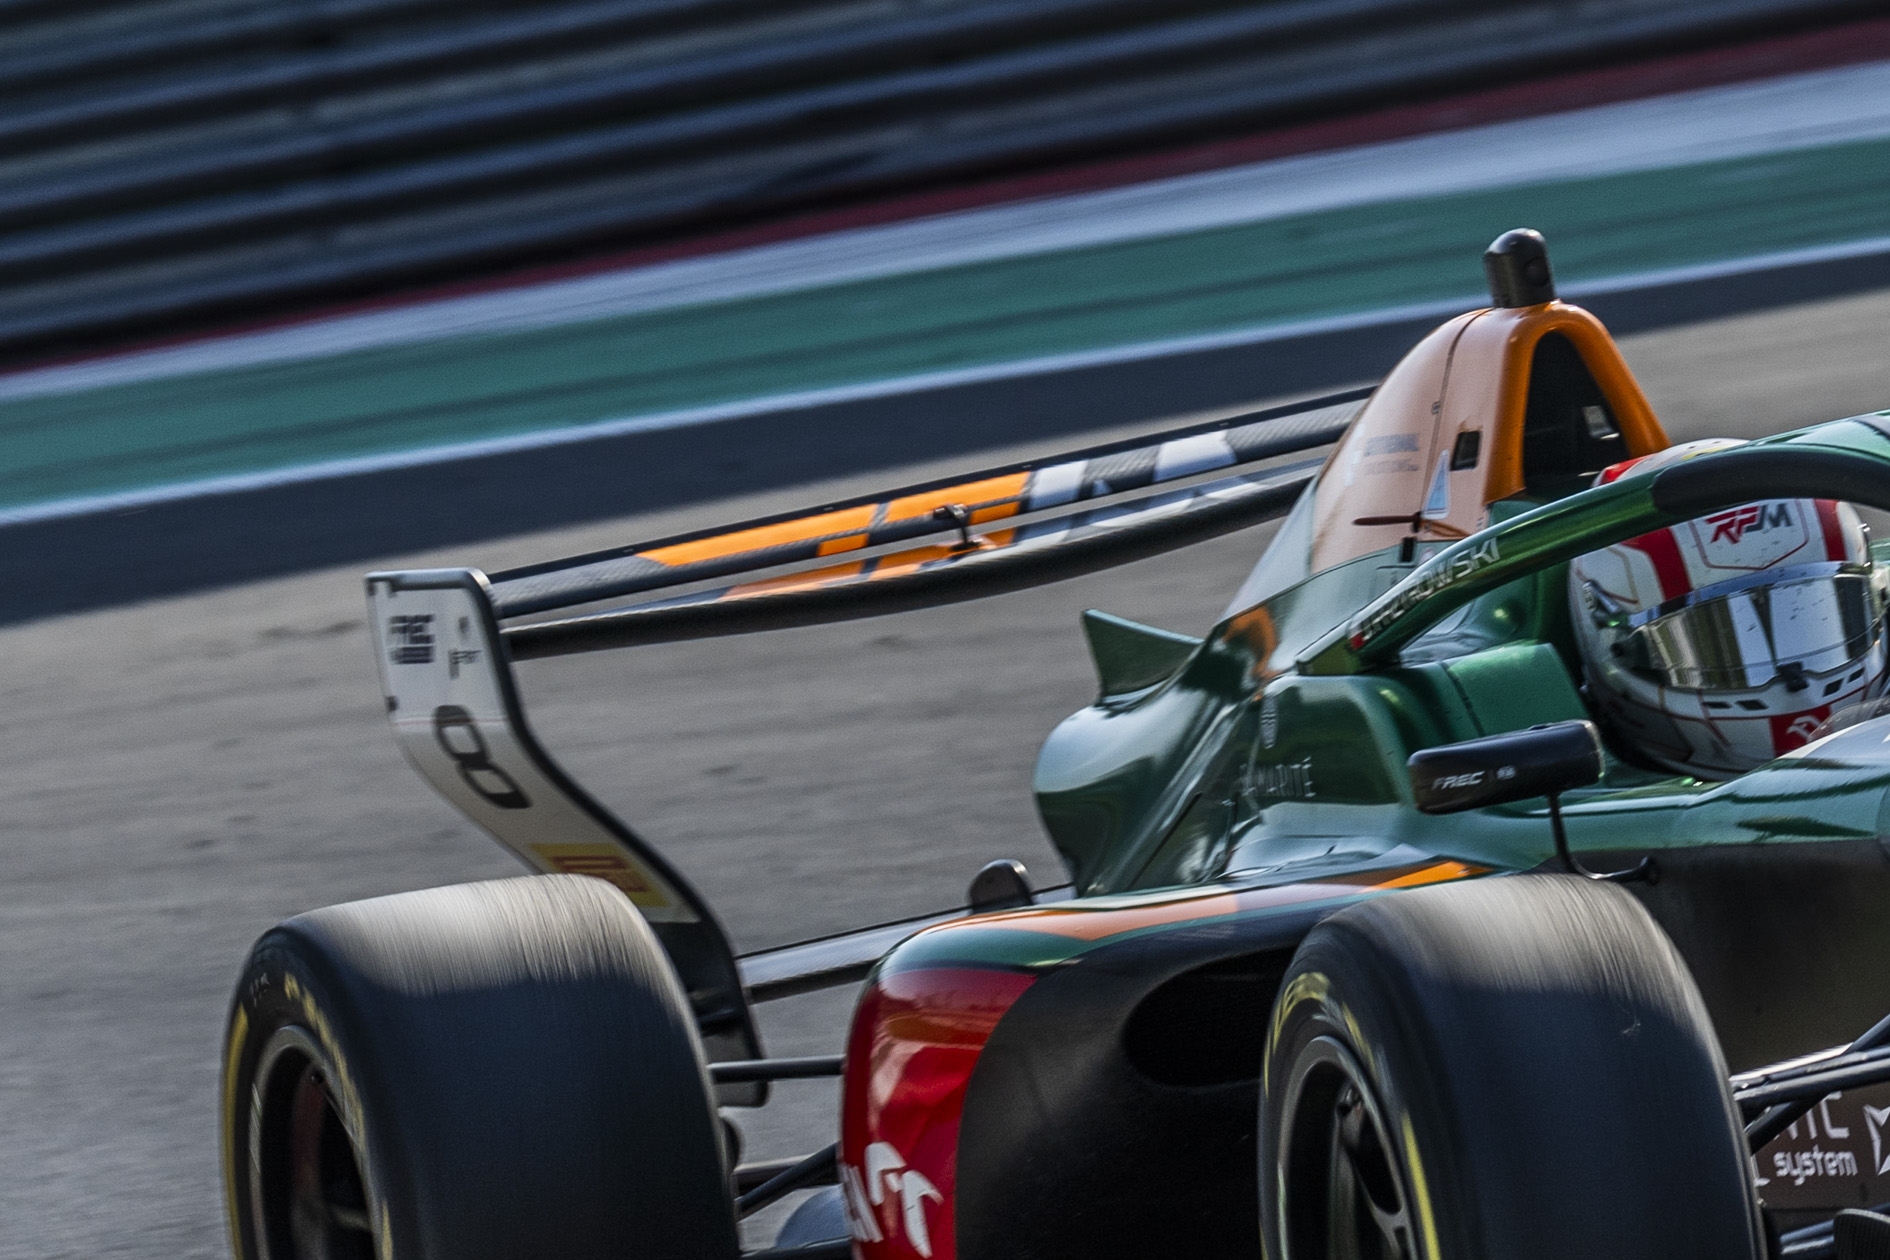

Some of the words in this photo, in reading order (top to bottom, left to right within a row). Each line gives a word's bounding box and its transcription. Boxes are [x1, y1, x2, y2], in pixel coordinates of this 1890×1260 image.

[432, 704, 532, 810] 8
[1432, 770, 1485, 791] FREC
[1773, 1144, 1858, 1186] system
